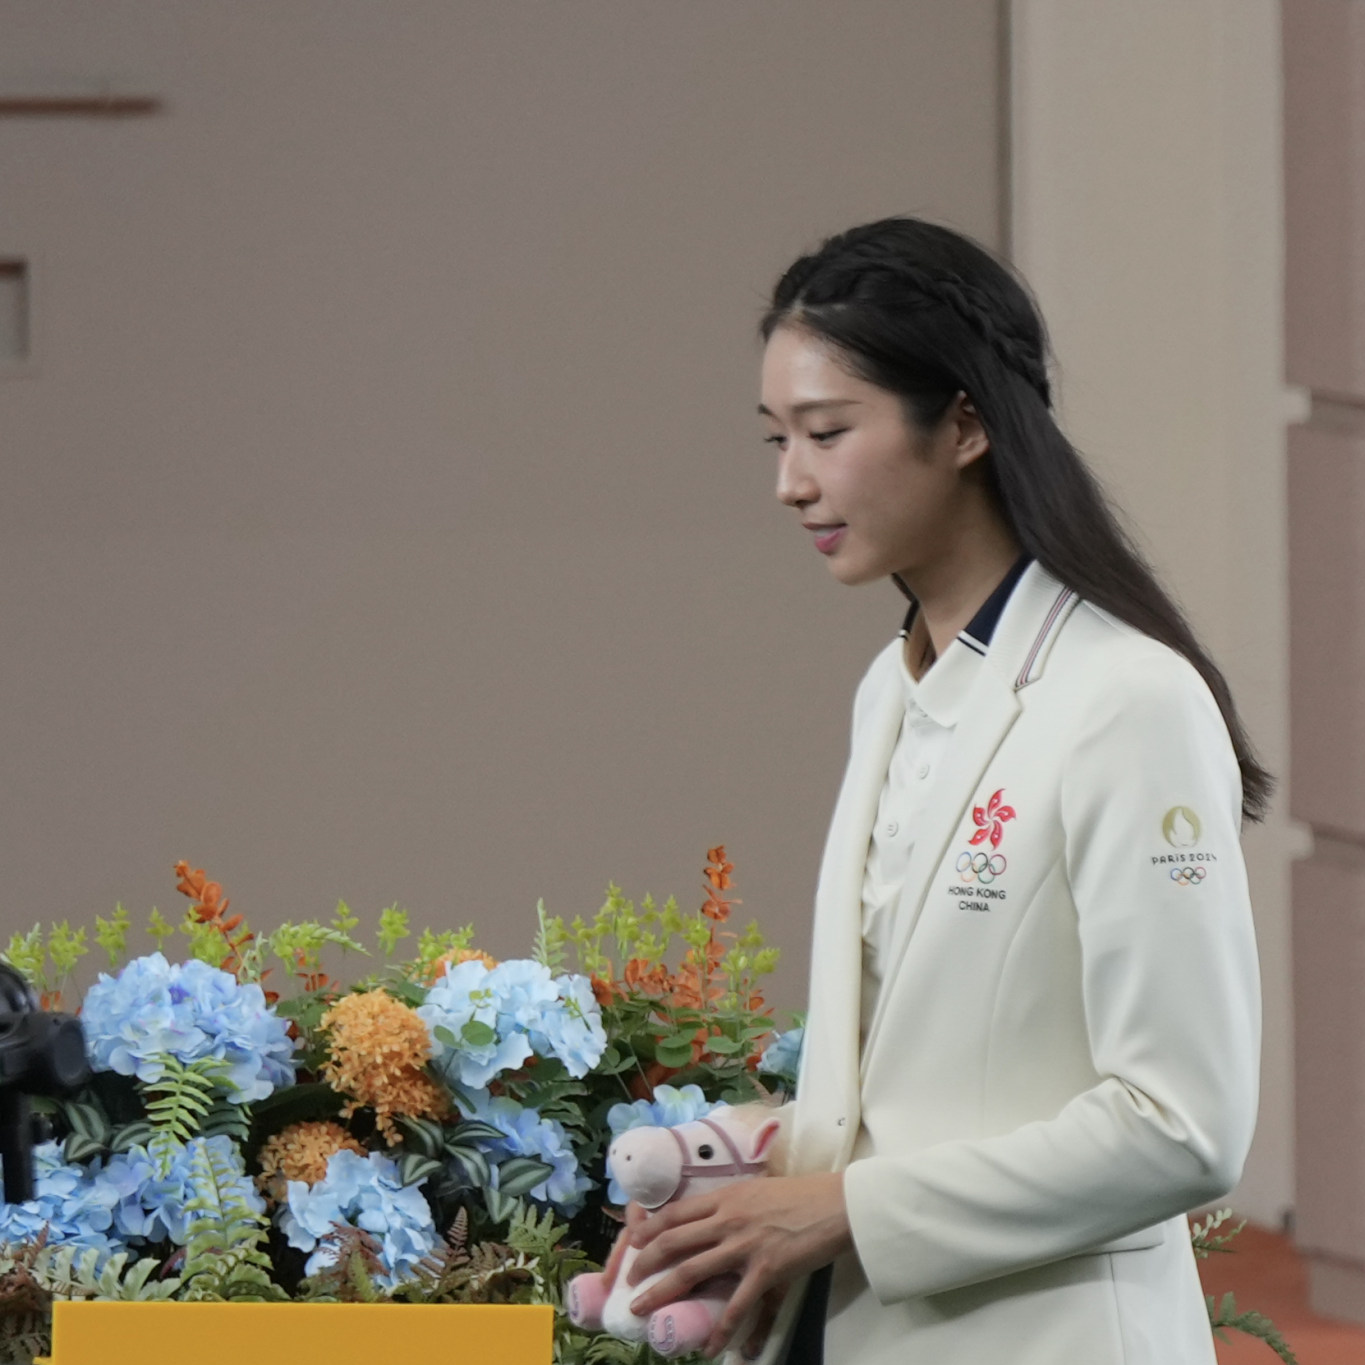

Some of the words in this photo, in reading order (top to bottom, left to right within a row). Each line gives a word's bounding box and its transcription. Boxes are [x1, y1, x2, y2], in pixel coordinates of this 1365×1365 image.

[948, 886, 974, 896] HONG
[976, 888, 1006, 900] KONG
[959, 901, 990, 912] CHINA
